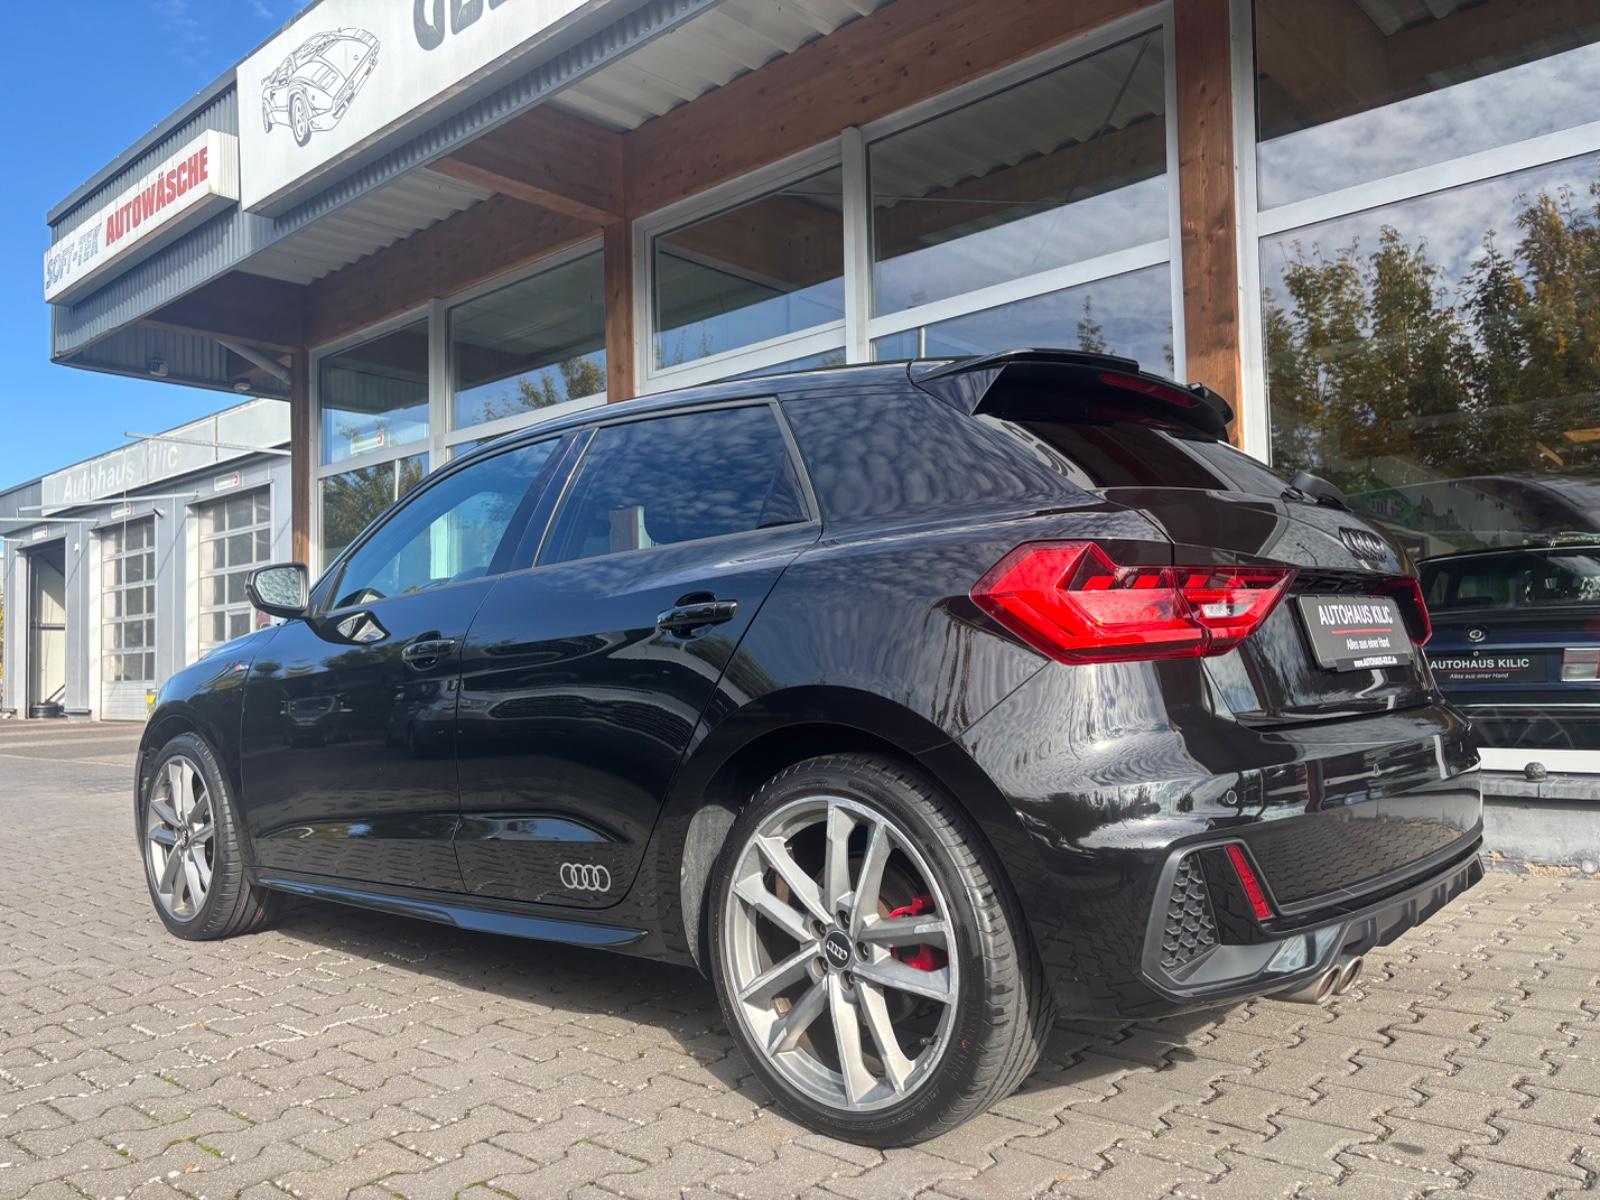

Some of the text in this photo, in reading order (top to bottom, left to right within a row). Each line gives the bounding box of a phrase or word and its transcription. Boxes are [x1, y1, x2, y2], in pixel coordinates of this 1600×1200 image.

[106, 146, 208, 247] AUTOWÄSCHE
[63, 460, 135, 503] Autohaus
[1318, 604, 1394, 625] AUTOHAUS KILIC
[1430, 658, 1530, 670] AUTOHAUS KILIC
